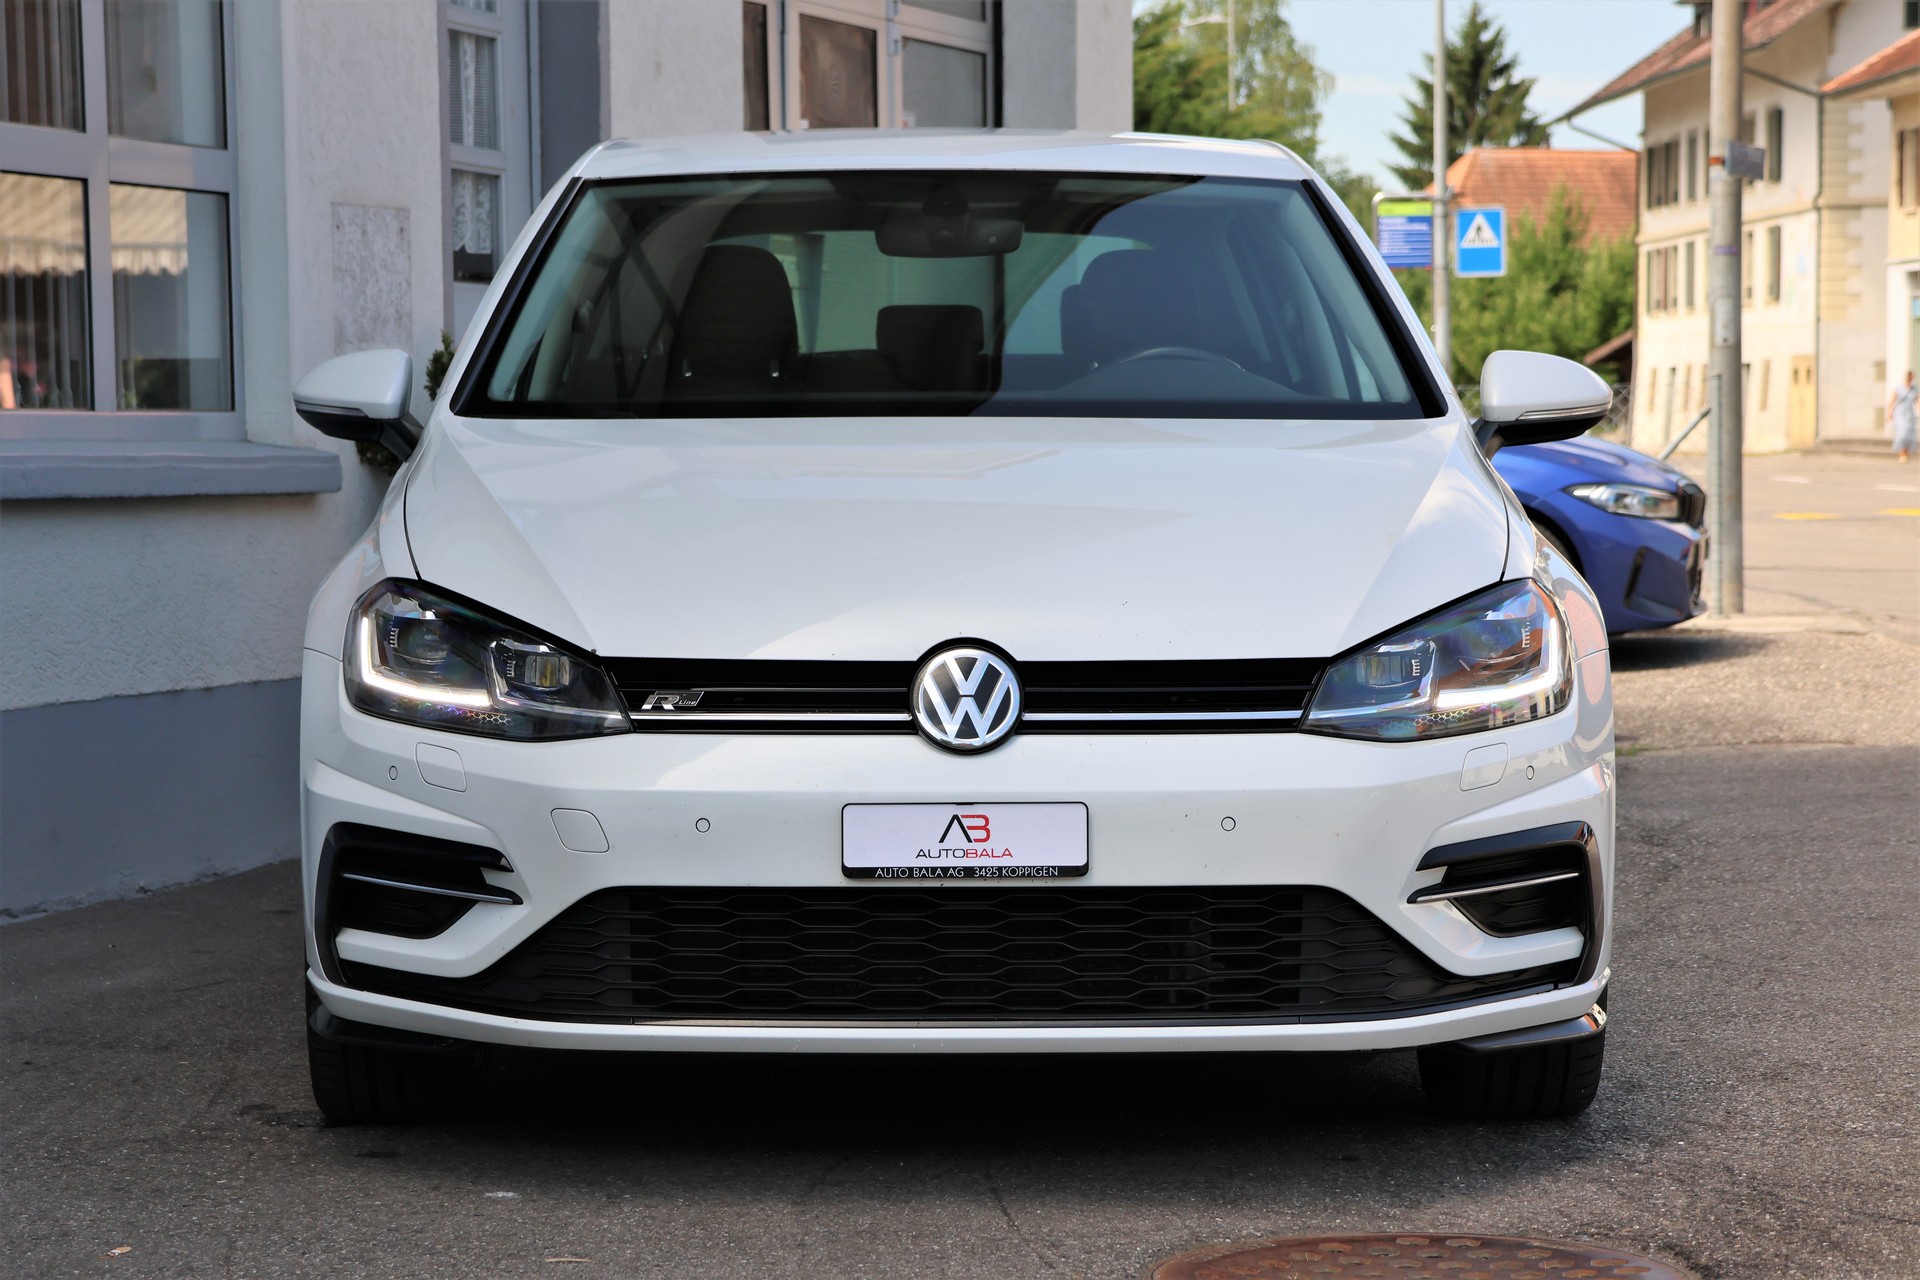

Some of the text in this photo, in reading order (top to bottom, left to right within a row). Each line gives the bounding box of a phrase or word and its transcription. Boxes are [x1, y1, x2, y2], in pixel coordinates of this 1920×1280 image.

[920, 650, 1013, 743] VW
[938, 814, 991, 843] AB
[915, 848, 1013, 859] AUTOBALA
[875, 866, 1058, 878] AUTO BALA AG 3425 KOPPIGEN
